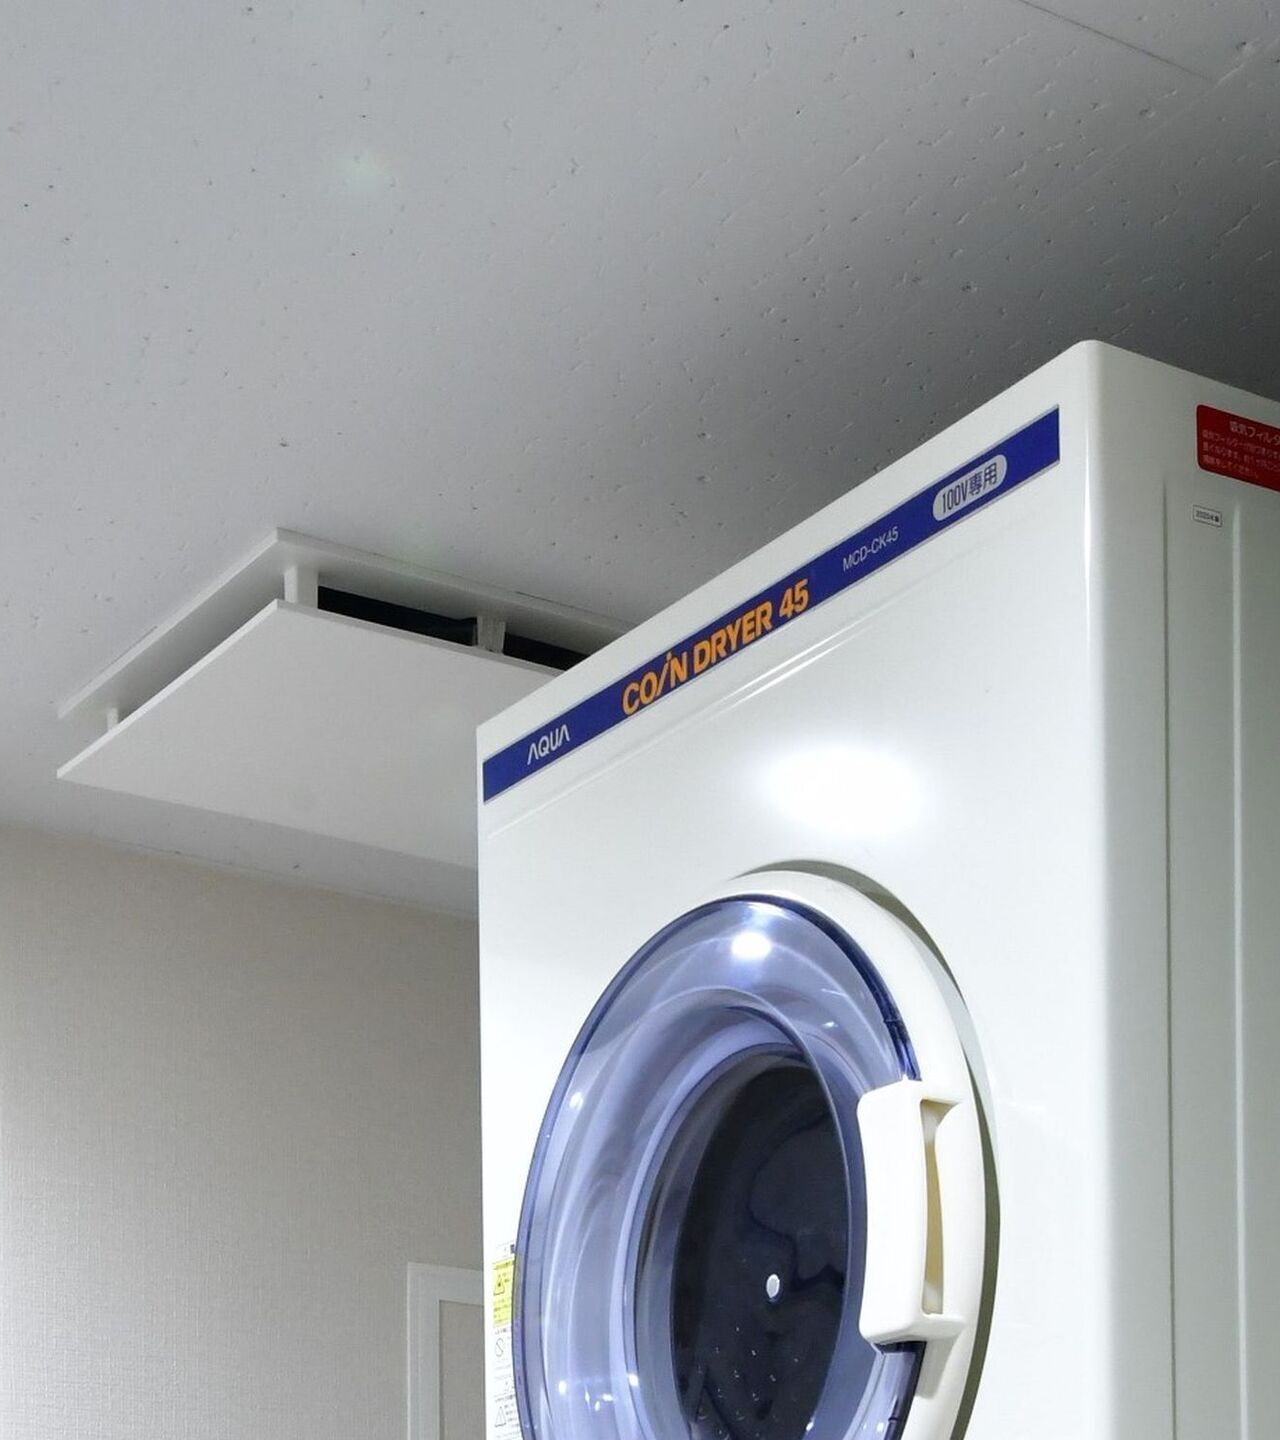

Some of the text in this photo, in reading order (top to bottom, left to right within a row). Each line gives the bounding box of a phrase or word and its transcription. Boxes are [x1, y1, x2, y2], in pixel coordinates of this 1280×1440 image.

[942, 461, 998, 514] 100V専用
[527, 525, 899, 766] AQUA COIN DRYER 45 MCD-CK45
